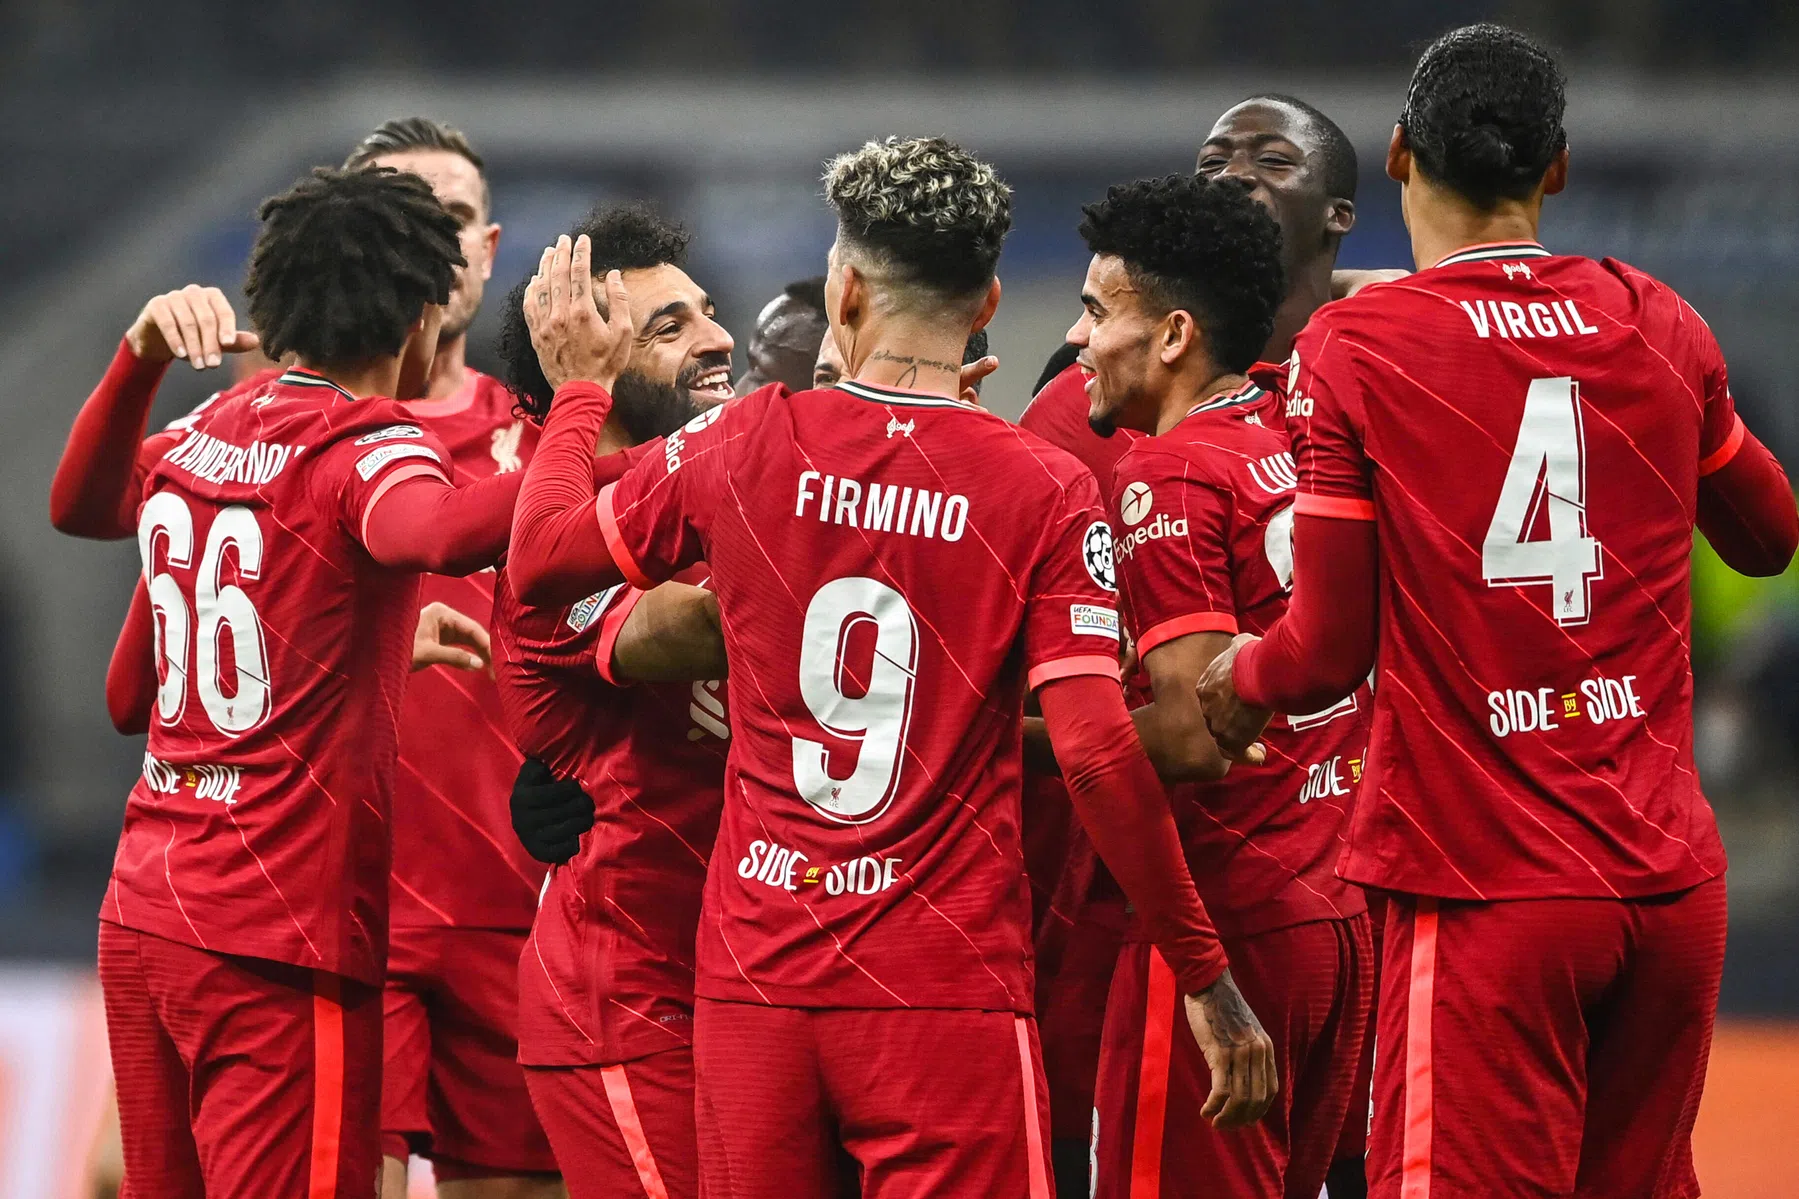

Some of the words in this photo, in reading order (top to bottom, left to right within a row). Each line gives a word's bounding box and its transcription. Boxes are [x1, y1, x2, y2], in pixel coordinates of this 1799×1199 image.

[1460, 300, 1599, 338] VIRGIL
[795, 470, 969, 542] FIRMINO
[1483, 376, 1603, 627] 4
[1113, 513, 1188, 564] Expedia
[138, 491, 272, 738] 66
[1073, 606, 1092, 614] UEFA
[792, 576, 920, 825] 9
[1487, 687, 1559, 738] SIDE
[1580, 675, 1645, 725] SIDE
[192, 764, 245, 804] SIDE
[738, 840, 809, 890] SIDE
